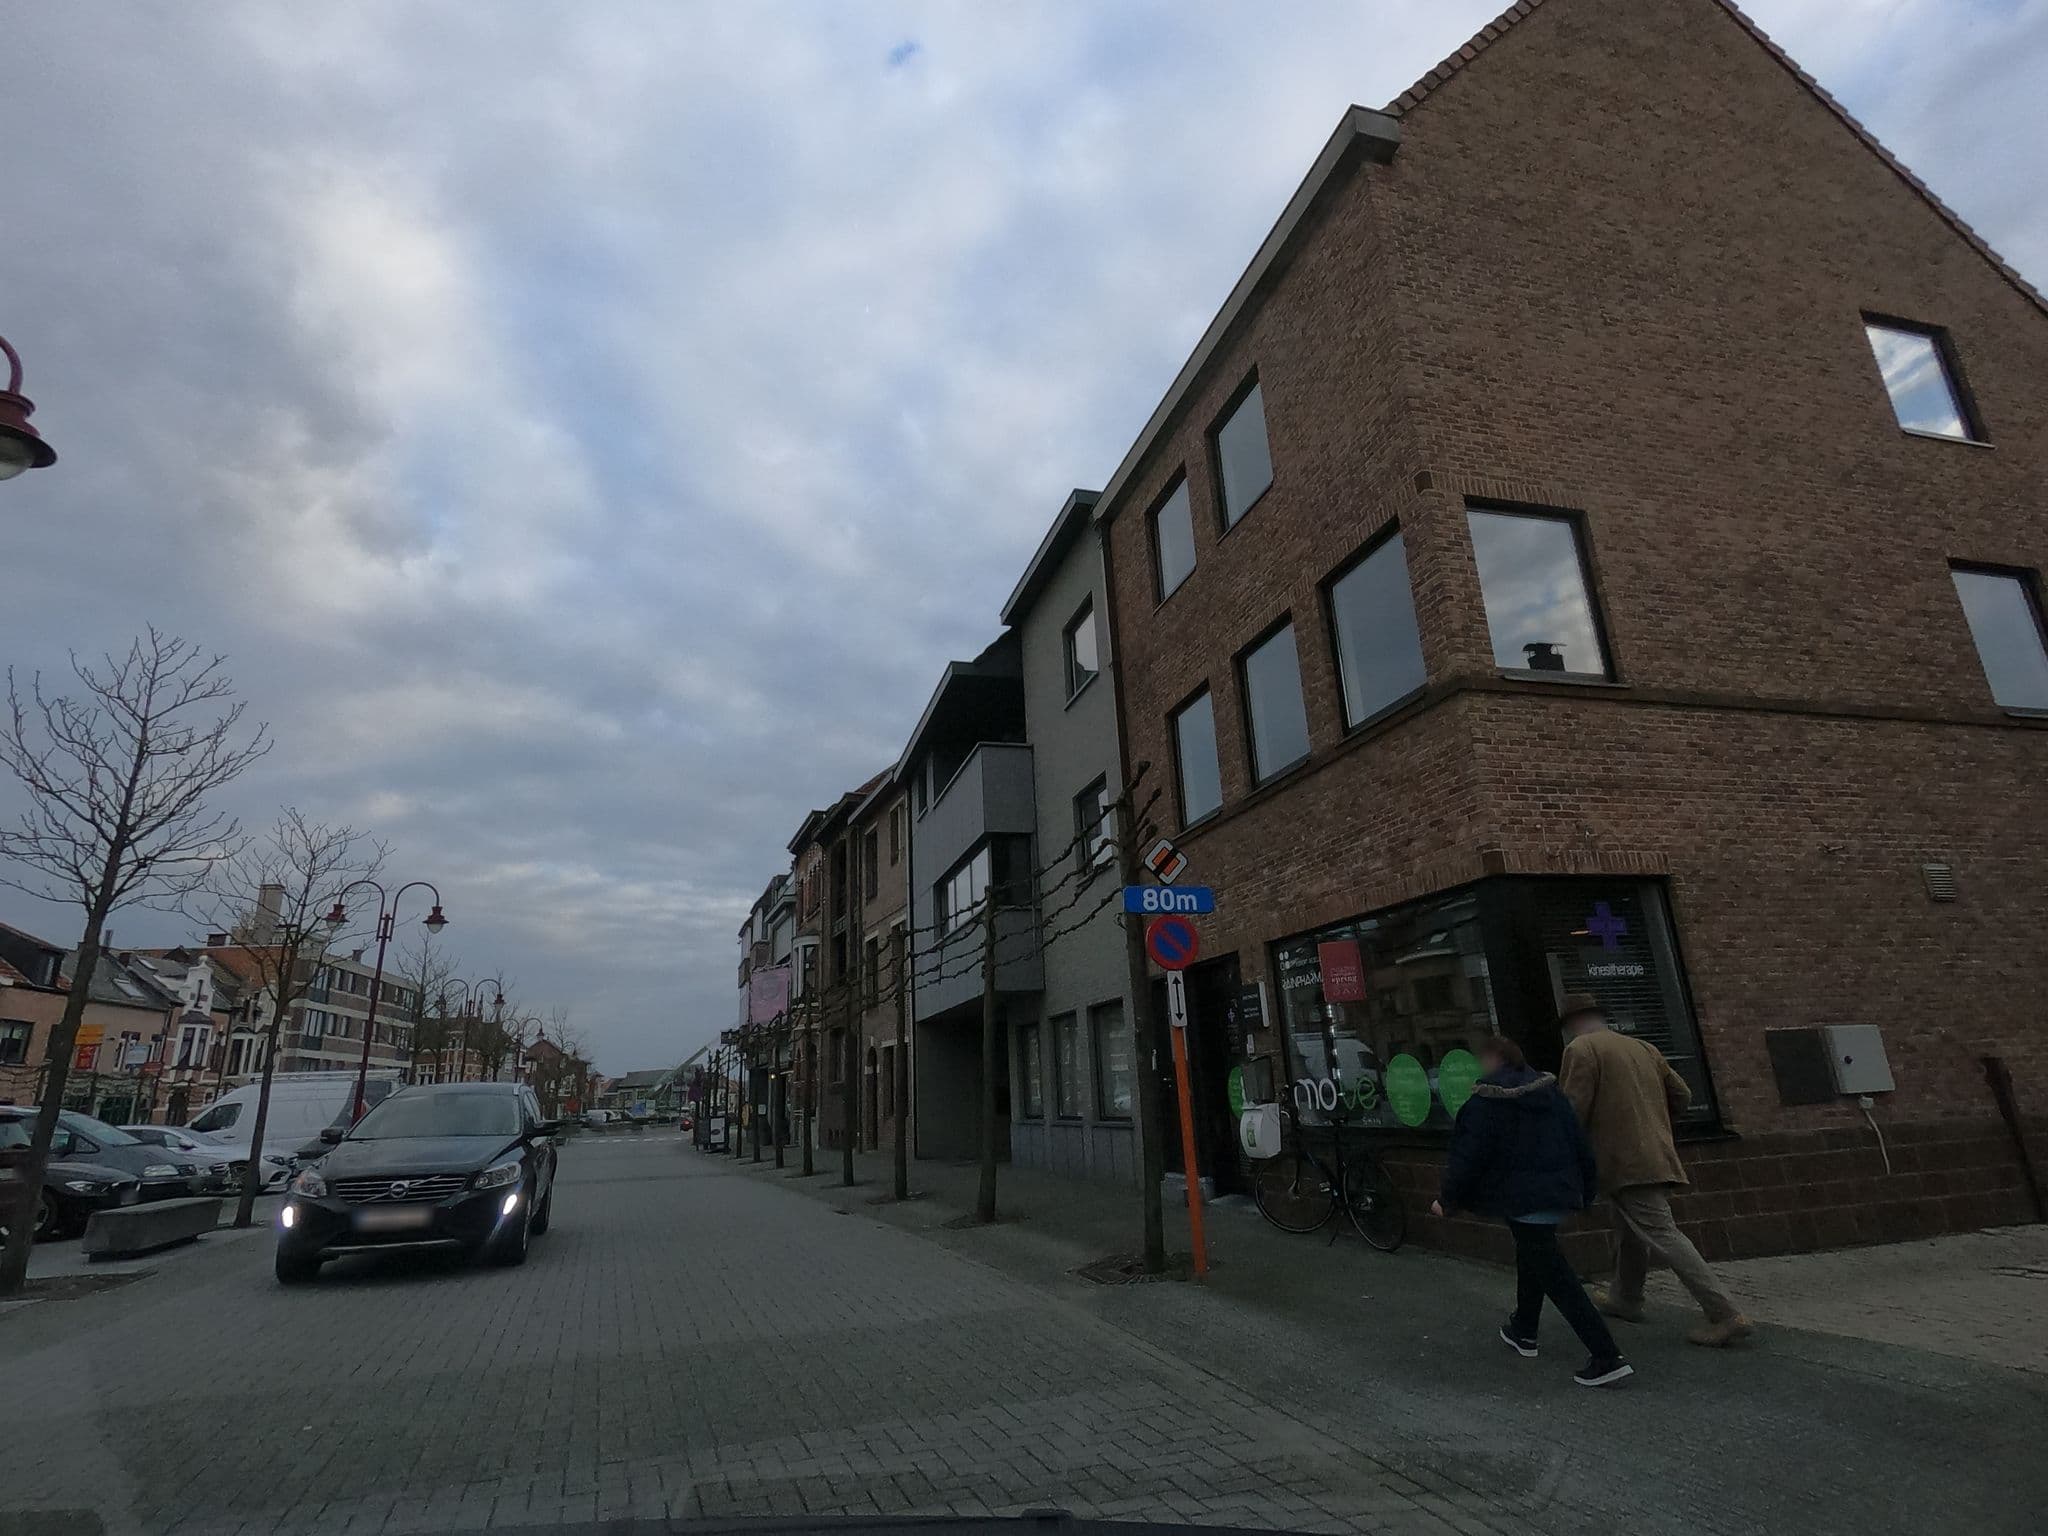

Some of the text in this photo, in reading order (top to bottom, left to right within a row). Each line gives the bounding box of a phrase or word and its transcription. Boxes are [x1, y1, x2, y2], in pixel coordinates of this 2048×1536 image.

[1142, 888, 1198, 912] 80m
[1281, 971, 1322, 991] RAINPHARM
[1294, 1074, 1377, 1112] move
